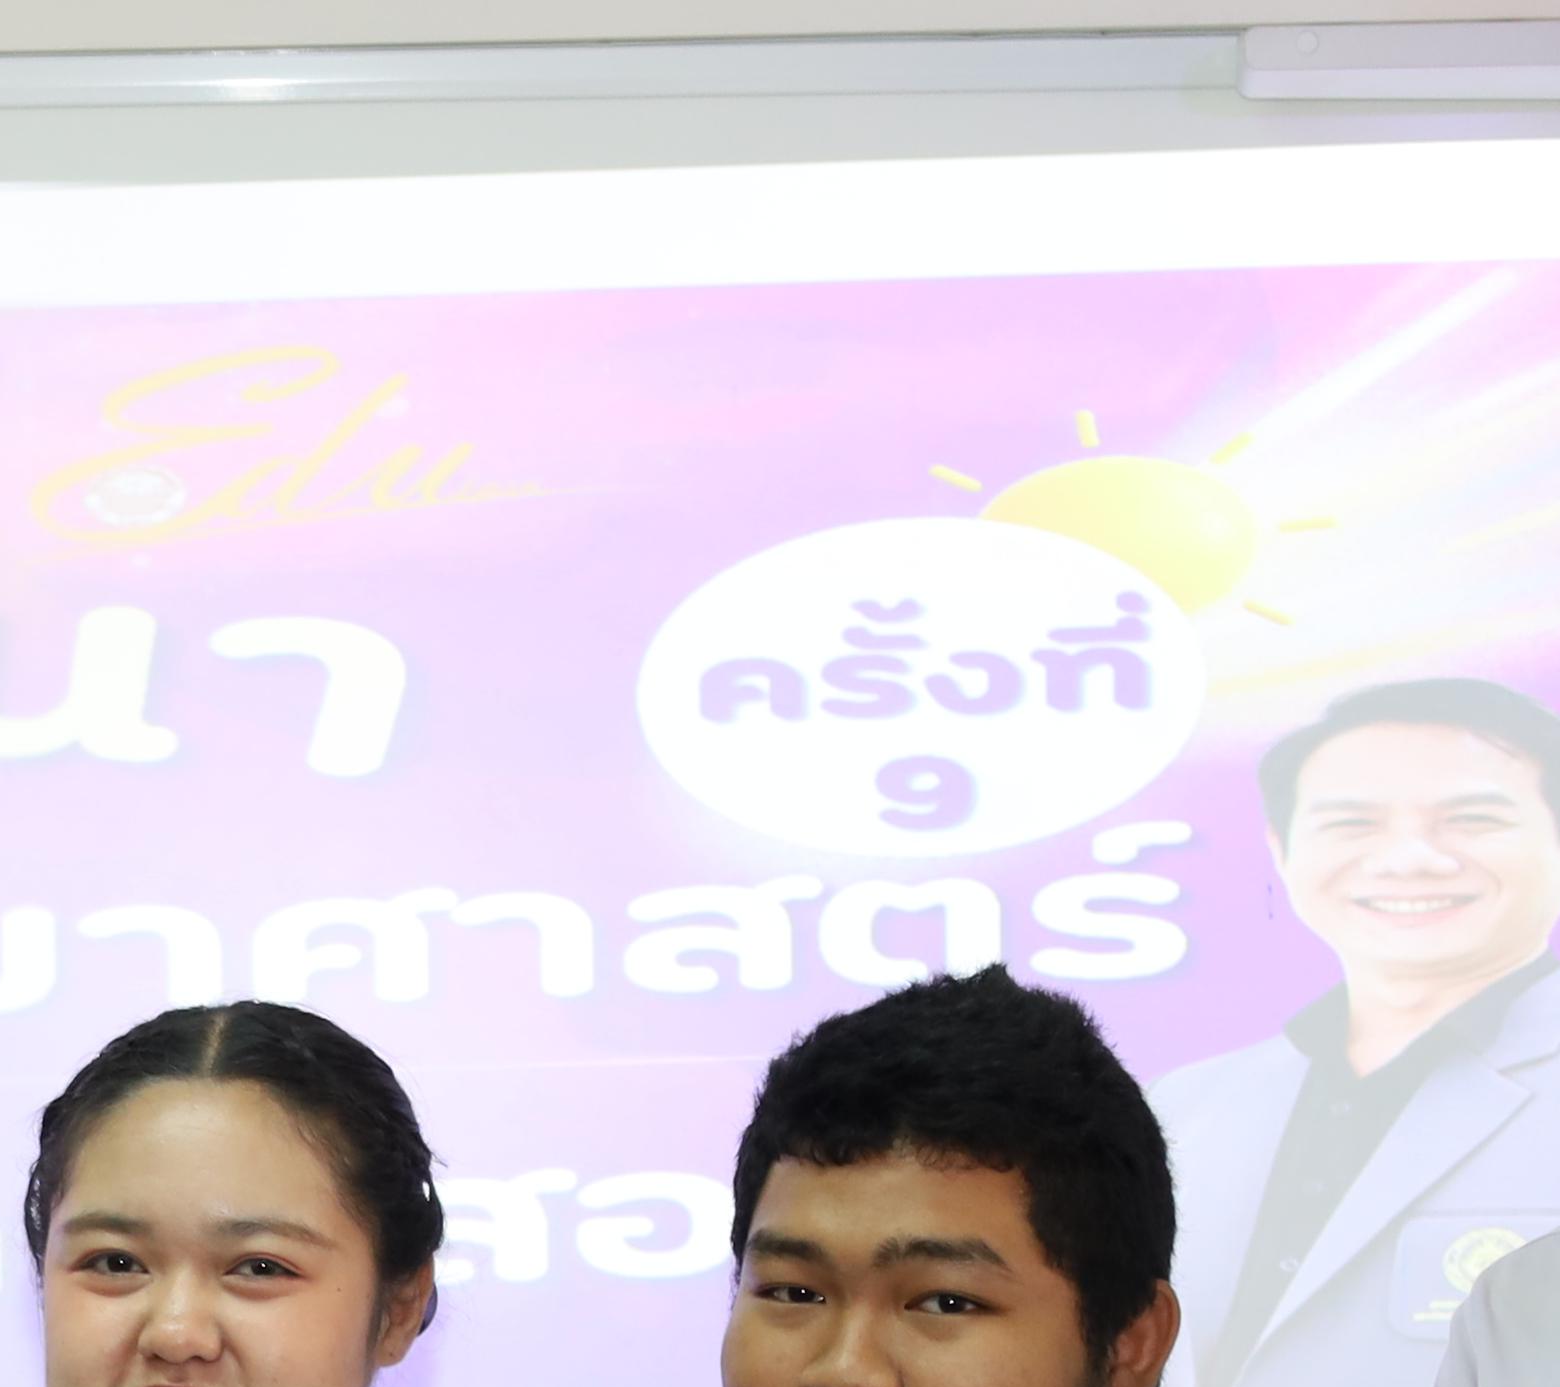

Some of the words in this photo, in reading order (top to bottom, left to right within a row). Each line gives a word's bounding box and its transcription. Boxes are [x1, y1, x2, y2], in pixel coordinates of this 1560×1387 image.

[698, 590, 1154, 723] ครั้งที่
[874, 754, 977, 831] 9
